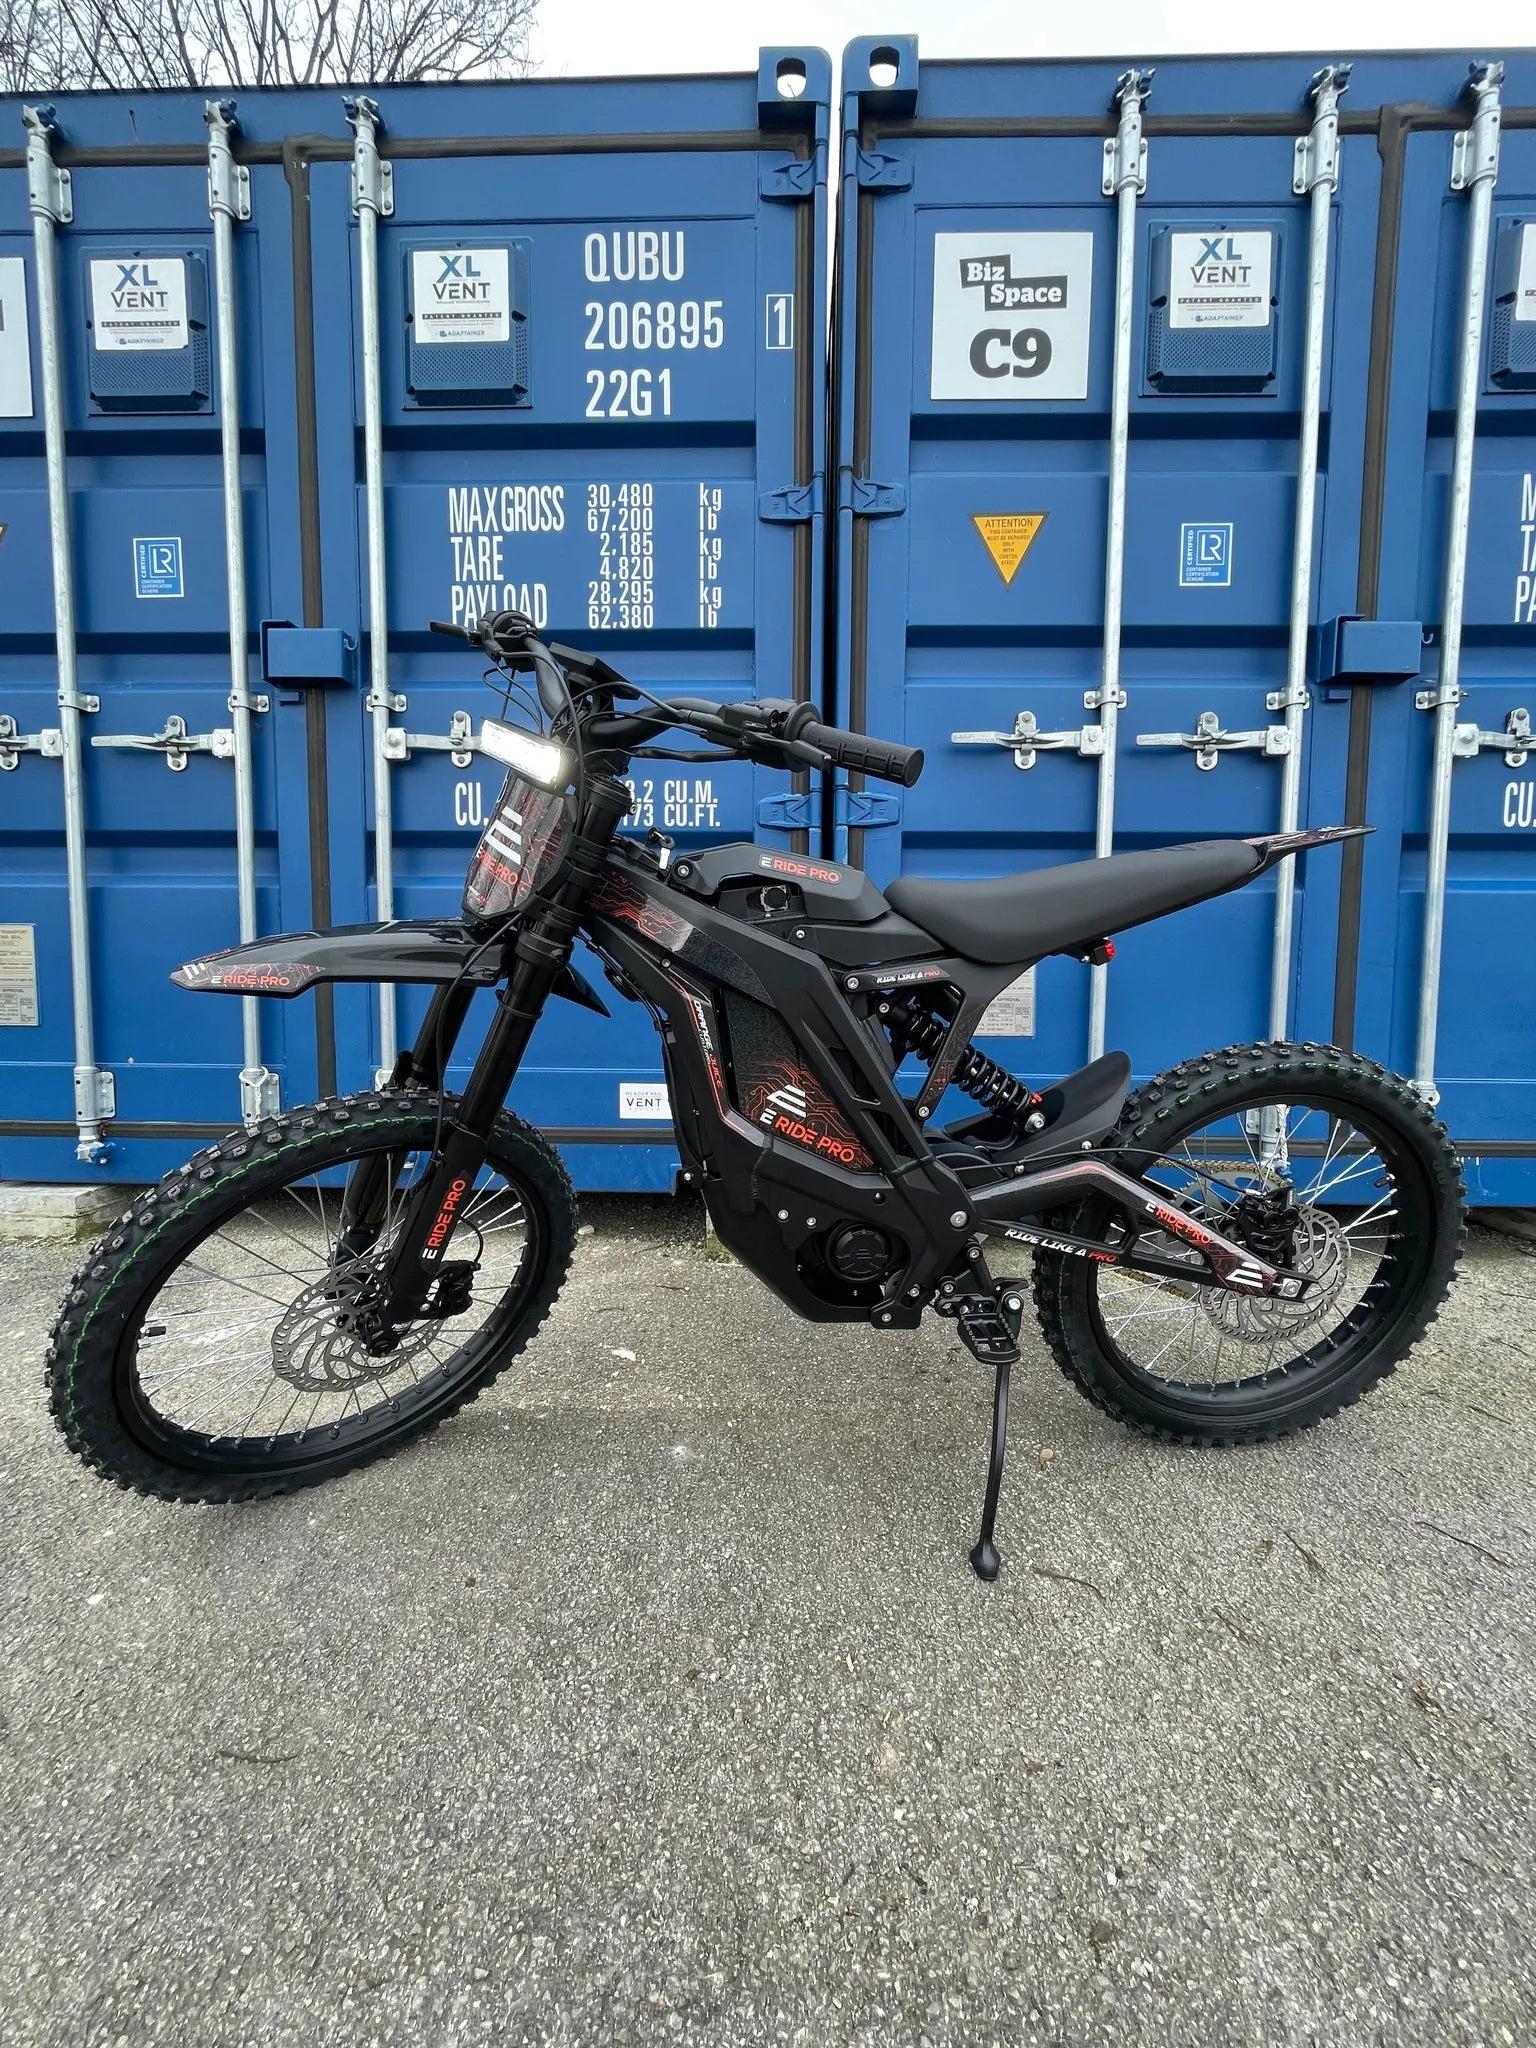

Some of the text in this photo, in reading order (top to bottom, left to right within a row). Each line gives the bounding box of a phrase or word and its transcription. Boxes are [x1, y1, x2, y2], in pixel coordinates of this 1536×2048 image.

[585, 232, 684, 282] QUBU
[1195, 238, 1242, 266] XL
[114, 264, 159, 291] XL
[436, 256, 481, 283] XL
[966, 261, 1005, 282] Biz
[1190, 266, 1251, 283] VENT
[111, 291, 168, 308] VENT
[433, 283, 491, 300] VENT
[990, 283, 1062, 307] Space
[585, 301, 723, 349] 206895
[773, 298, 786, 346] 1
[969, 328, 1052, 378] C9
[585, 369, 671, 418] 22G1
[449, 485, 565, 533] MAX GROSS
[587, 483, 722, 511] 30,480 kg
[587, 507, 718, 532] 67,200 lb
[985, 518, 1033, 528] ATTENTION
[450, 535, 504, 581] TARE
[600, 532, 722, 560] 2,185 kg
[1186, 529, 1194, 566] CERTIFIED
[1201, 534, 1222, 561] LR
[152, 548, 174, 573] LR
[600, 556, 718, 581] 4,820 lb
[588, 580, 722, 609] 28,295 kg
[588, 605, 718, 629] 62,380 lb
[664, 780, 718, 804] CU.M.
[664, 804, 721, 827] CU.FT.
[495, 862, 519, 886] PRO
[761, 856, 839, 882] E RIDE PRO
[210, 975, 290, 987] E RIDE PRO
[694, 1000, 714, 1051] ORANGE
[626, 1097, 663, 1107] VENT
[760, 1107, 855, 1162] E RIDE PRO
[422, 1179, 466, 1260] E RIDE PRO
[1145, 1199, 1212, 1244] E RIDE PRO
[1004, 1228, 1117, 1263] RIDE LIKE A PRO
